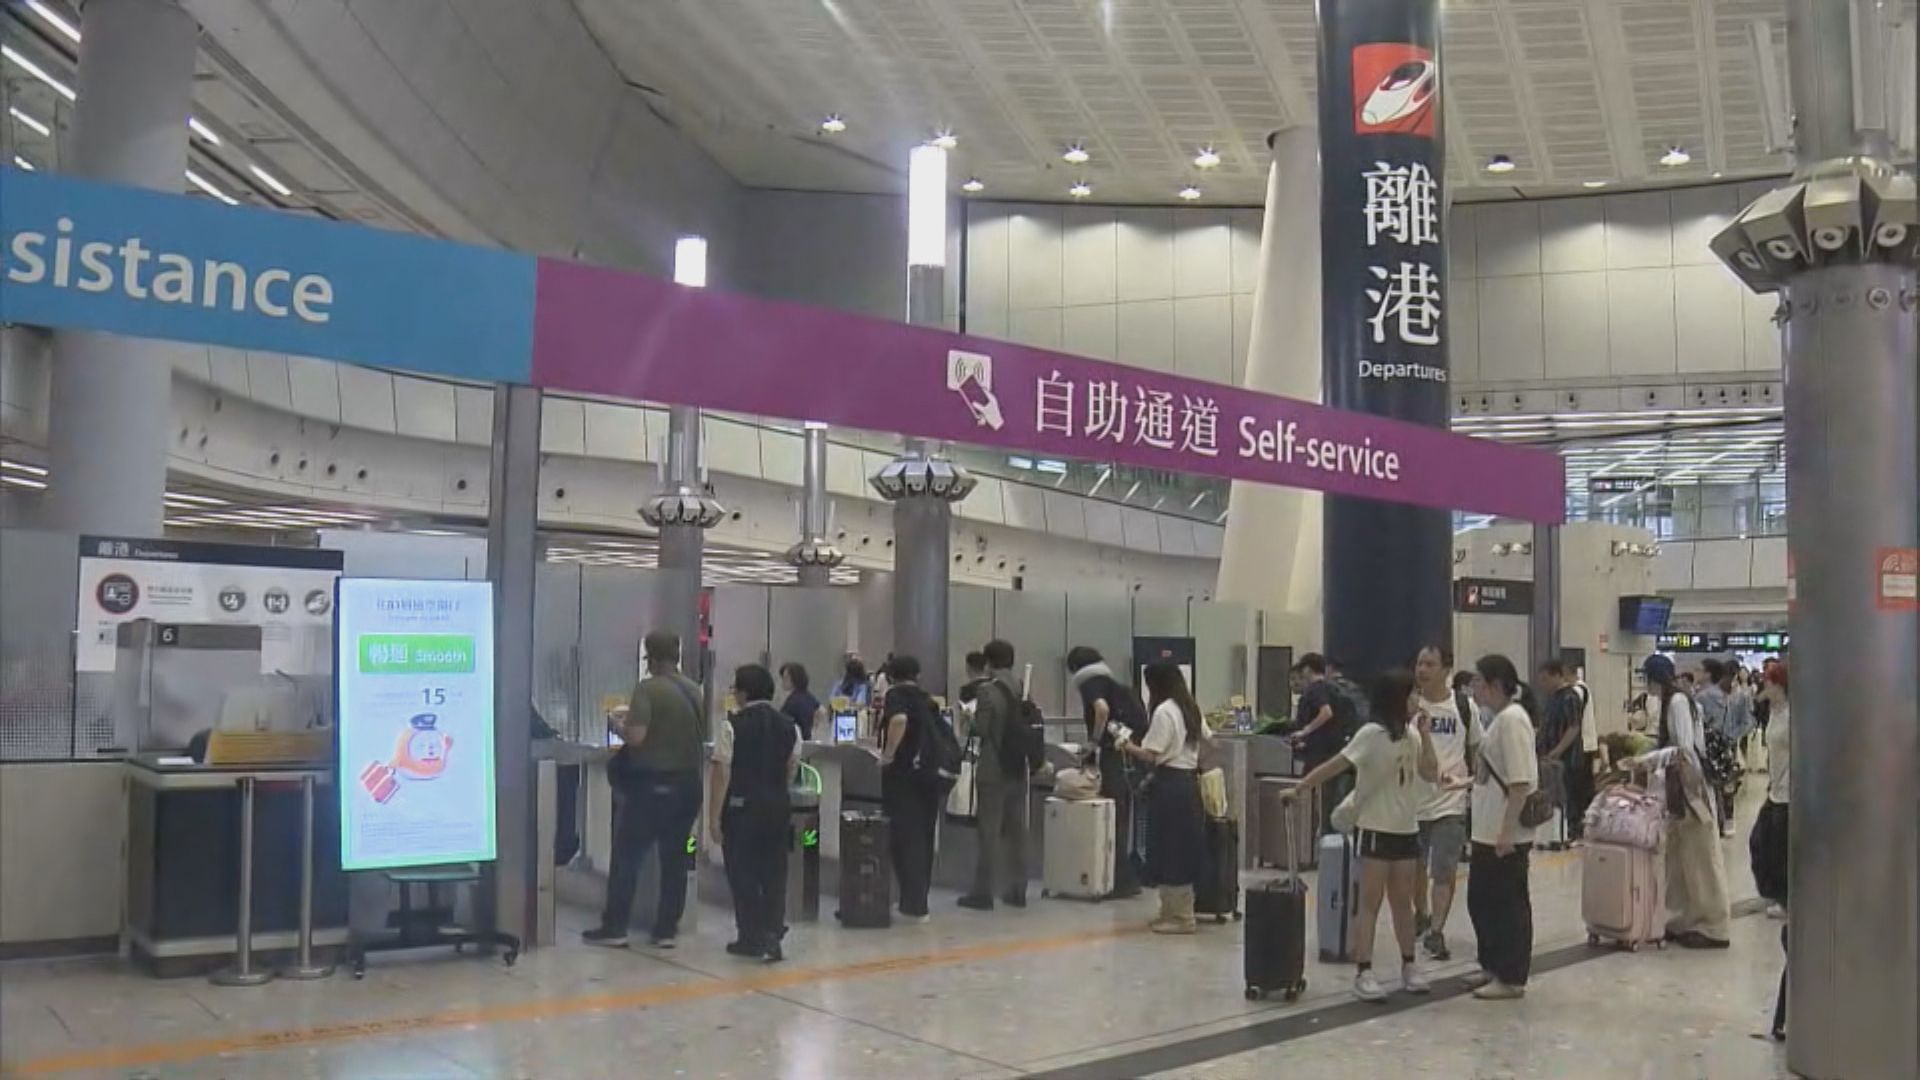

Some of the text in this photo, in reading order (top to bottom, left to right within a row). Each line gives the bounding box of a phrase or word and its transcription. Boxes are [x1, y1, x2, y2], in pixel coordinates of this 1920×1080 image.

[8, 217, 333, 322] sistance
[1361, 160, 1441, 346] 離港
[1359, 360, 1447, 383] Departures
[1036, 371, 1400, 480] 自助通道 Self-service
[162, 627, 174, 642] 6
[422, 688, 446, 705] 15
